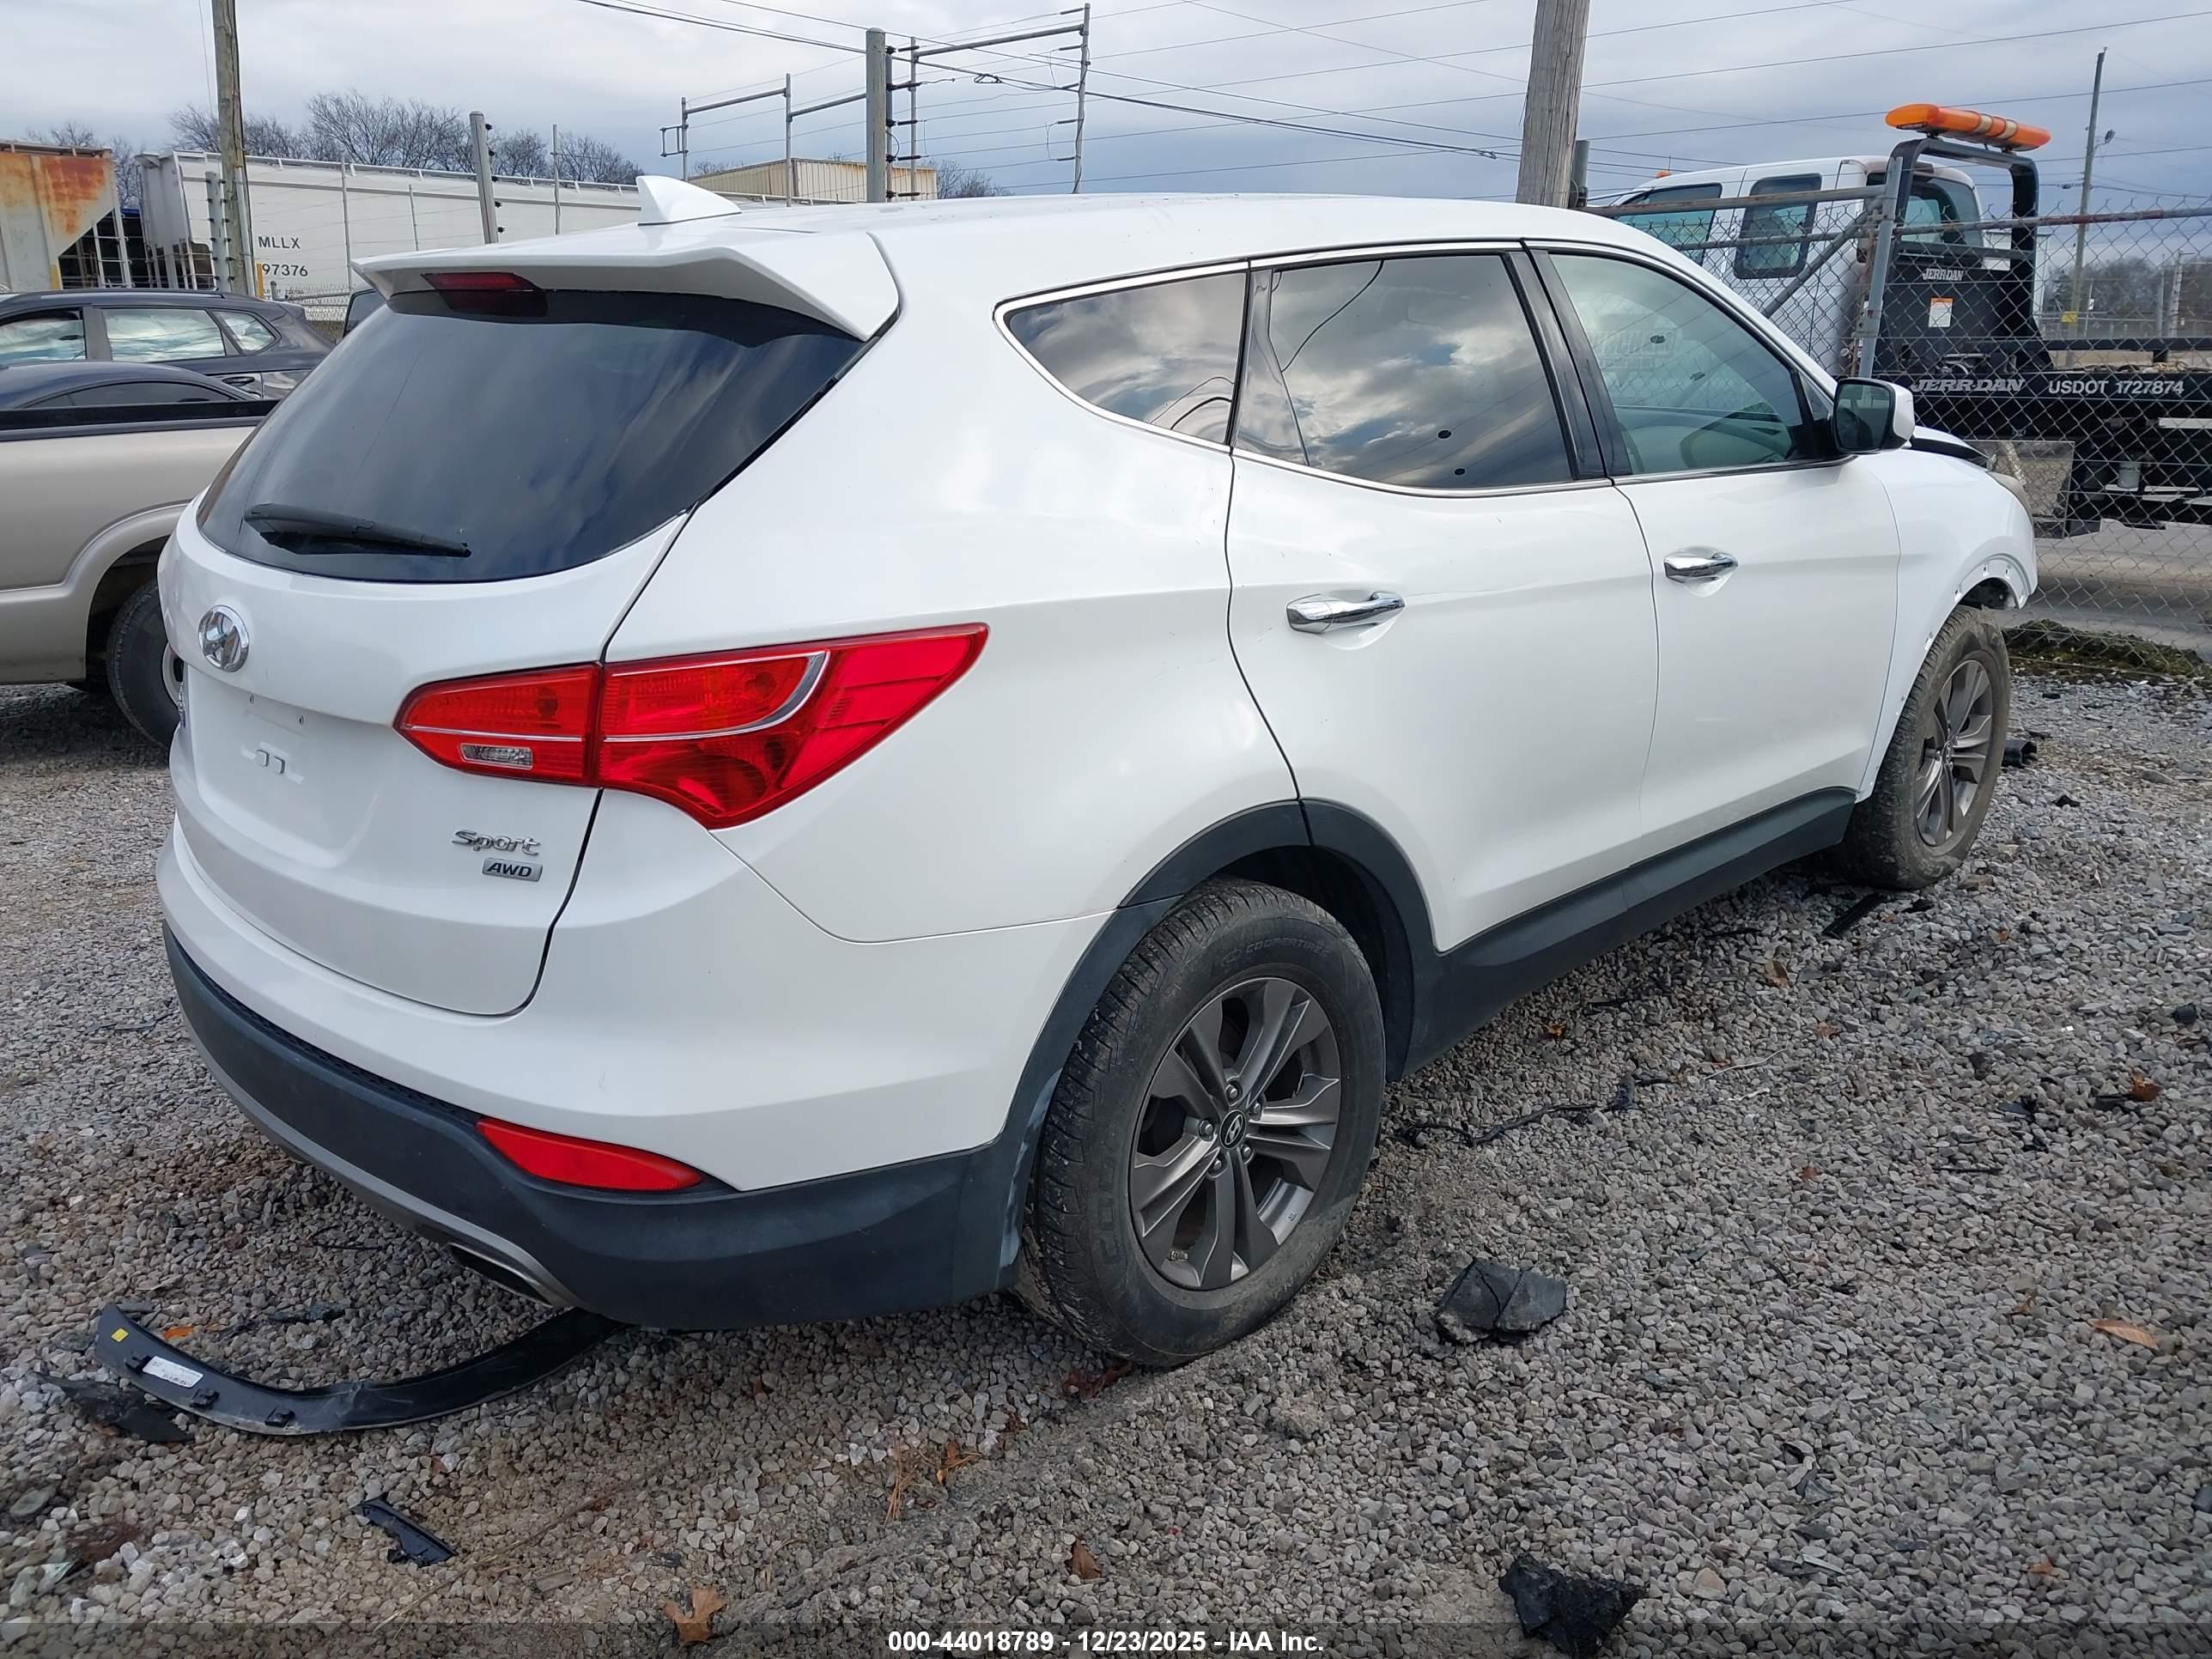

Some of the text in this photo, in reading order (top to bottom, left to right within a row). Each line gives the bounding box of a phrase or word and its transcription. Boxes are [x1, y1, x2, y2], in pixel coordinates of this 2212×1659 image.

[258, 236, 301, 249] MLLX
[262, 264, 308, 276] 97376
[2049, 380, 2185, 394] USDOT 1727874
[452, 830, 541, 856] Sport
[487, 862, 532, 878] AWD
